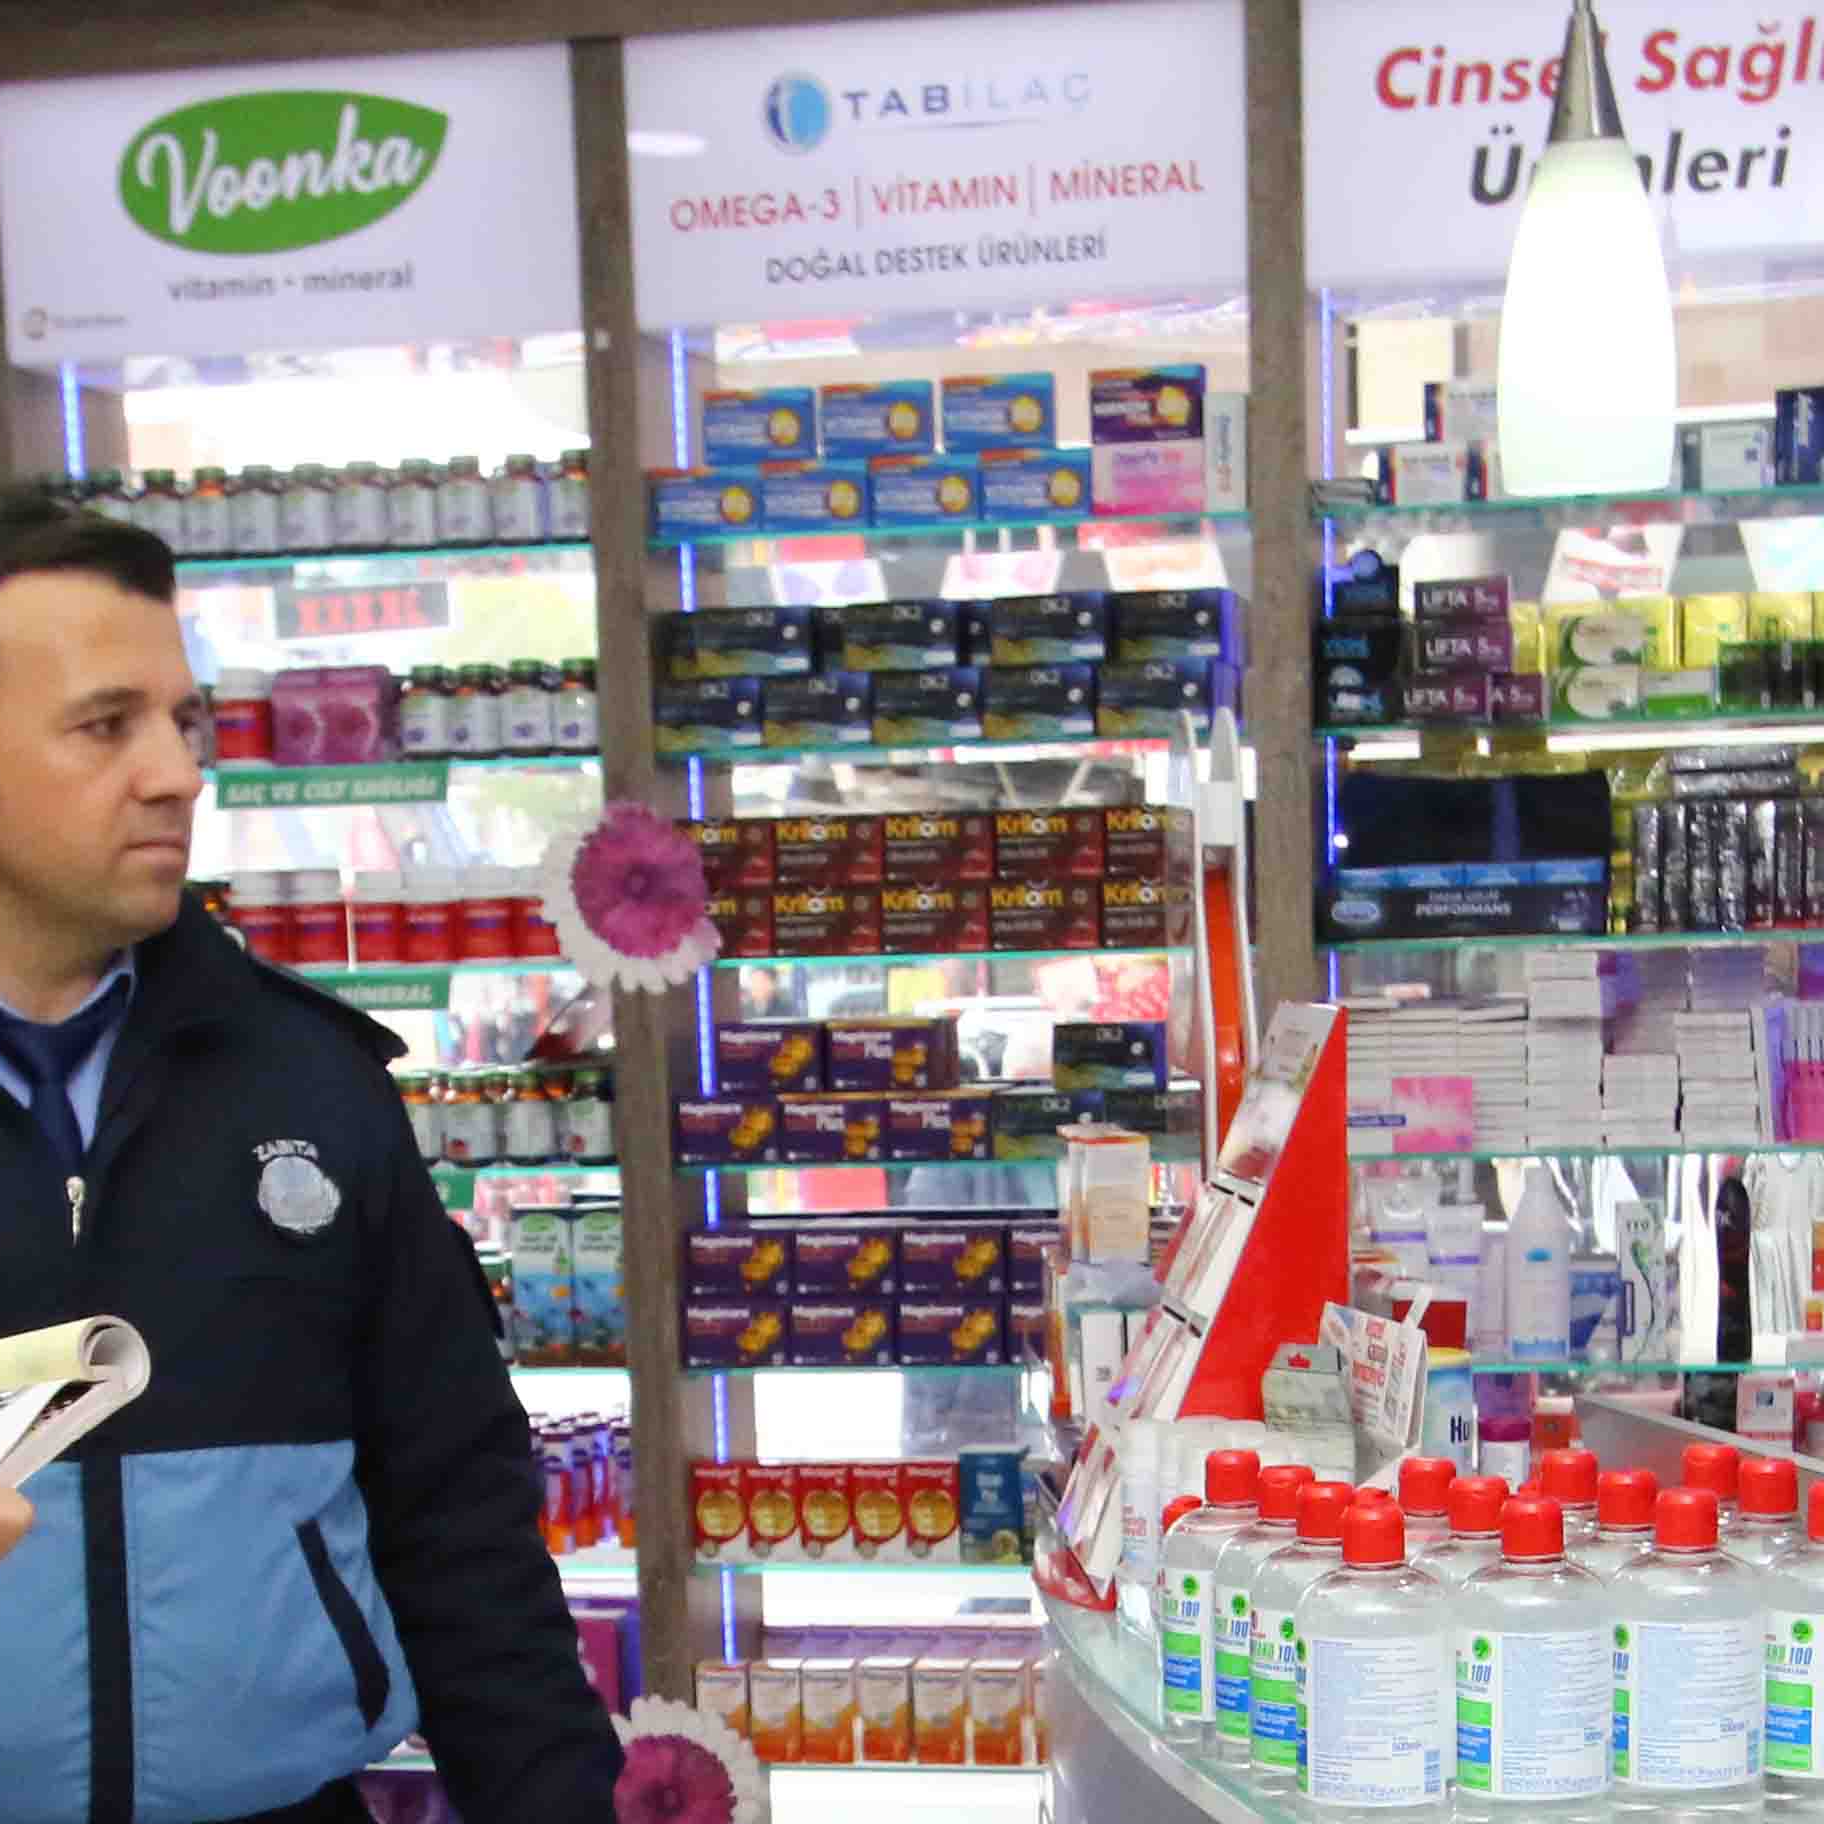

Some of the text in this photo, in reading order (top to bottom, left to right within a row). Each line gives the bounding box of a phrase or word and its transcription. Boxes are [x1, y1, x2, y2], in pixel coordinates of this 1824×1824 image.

[1376, 28, 1604, 108] Cinse
[136, 102, 425, 235] Voonka
[670, 184, 841, 233] OMEGA-3
[1050, 158, 1205, 204] MİNERAL
[167, 262, 414, 301] vitamin mineral
[765, 231, 1108, 285] DOĞAL DESTEK ÜRÜNLERİ
